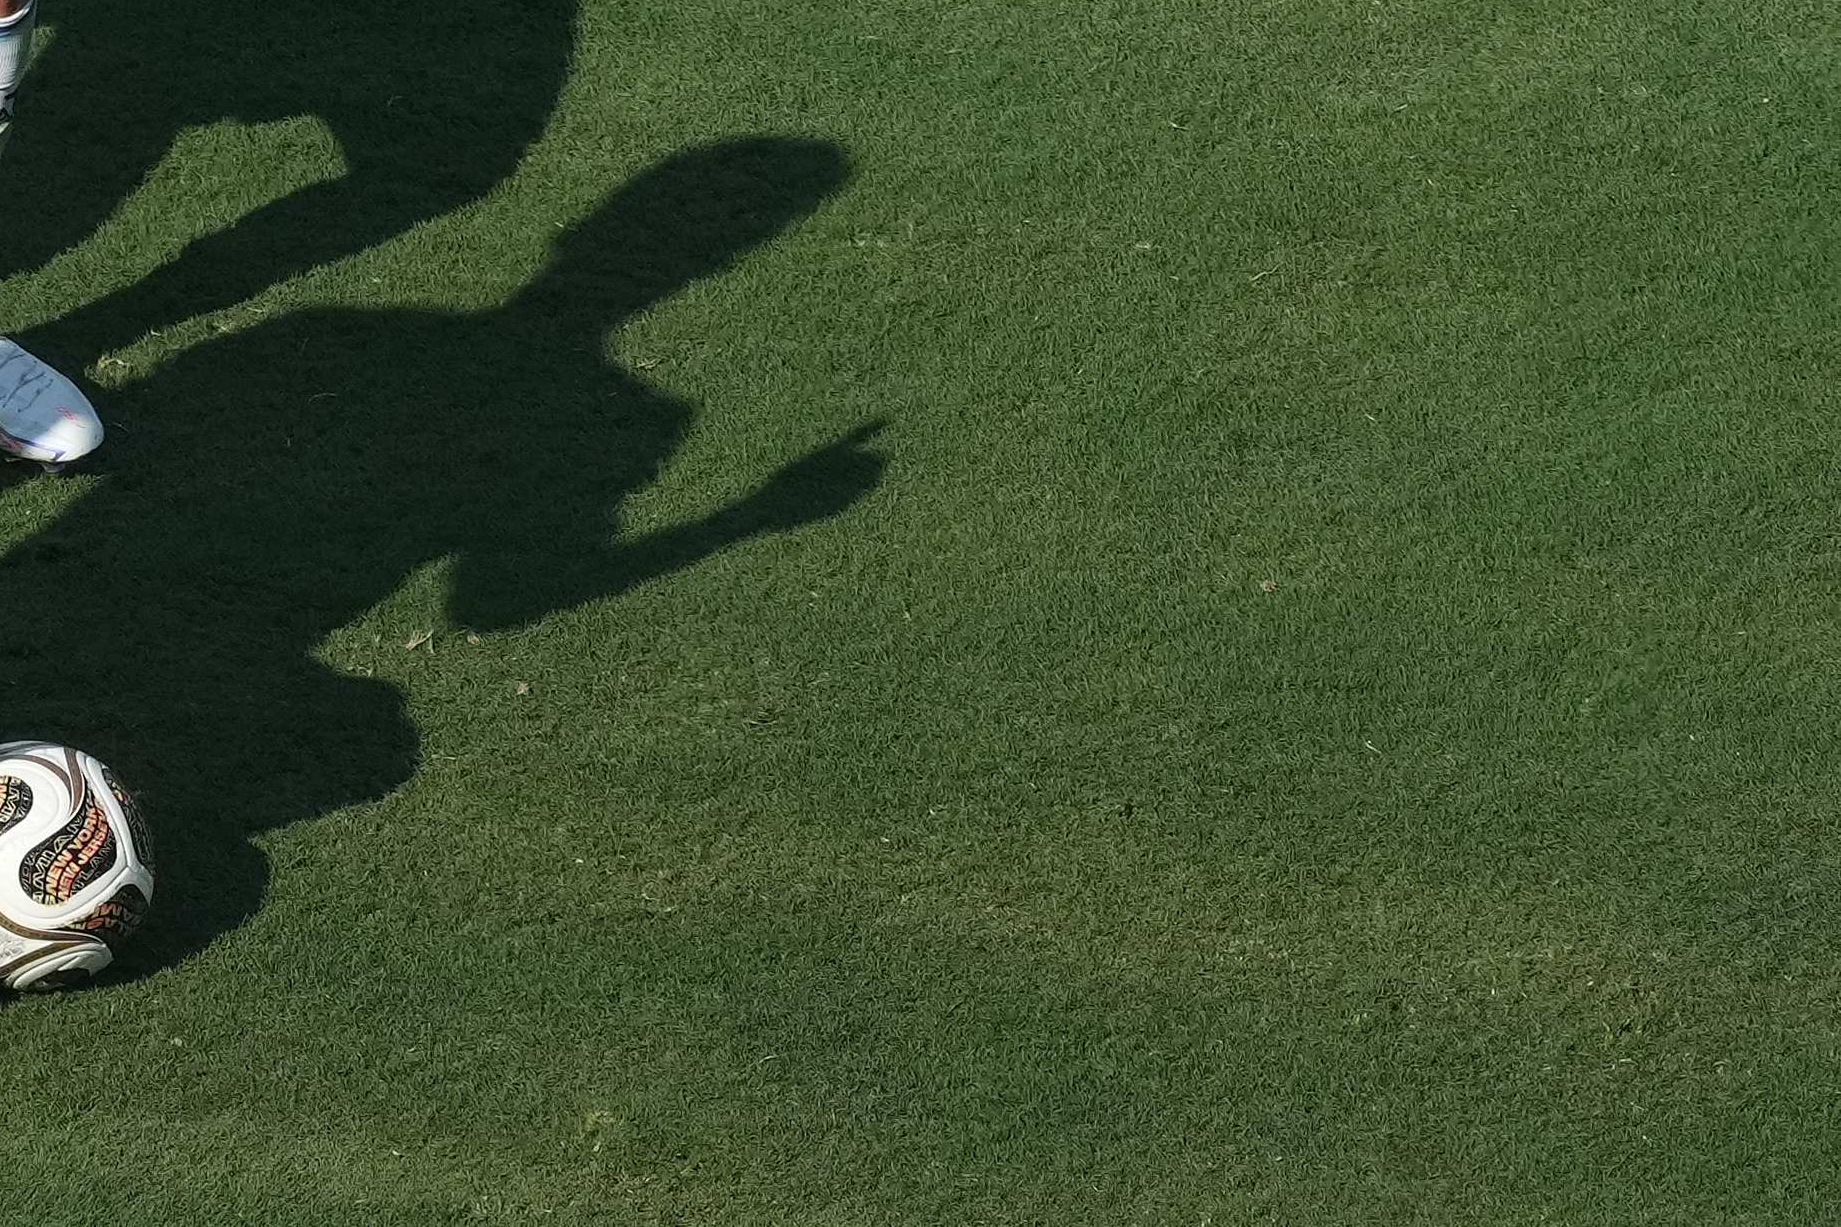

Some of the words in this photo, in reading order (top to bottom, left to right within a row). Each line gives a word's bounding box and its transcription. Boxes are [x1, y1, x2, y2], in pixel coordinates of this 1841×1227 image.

[45, 849, 75, 896] NEW
[67, 803, 99, 850] YORK
[58, 861, 81, 900] NEW
